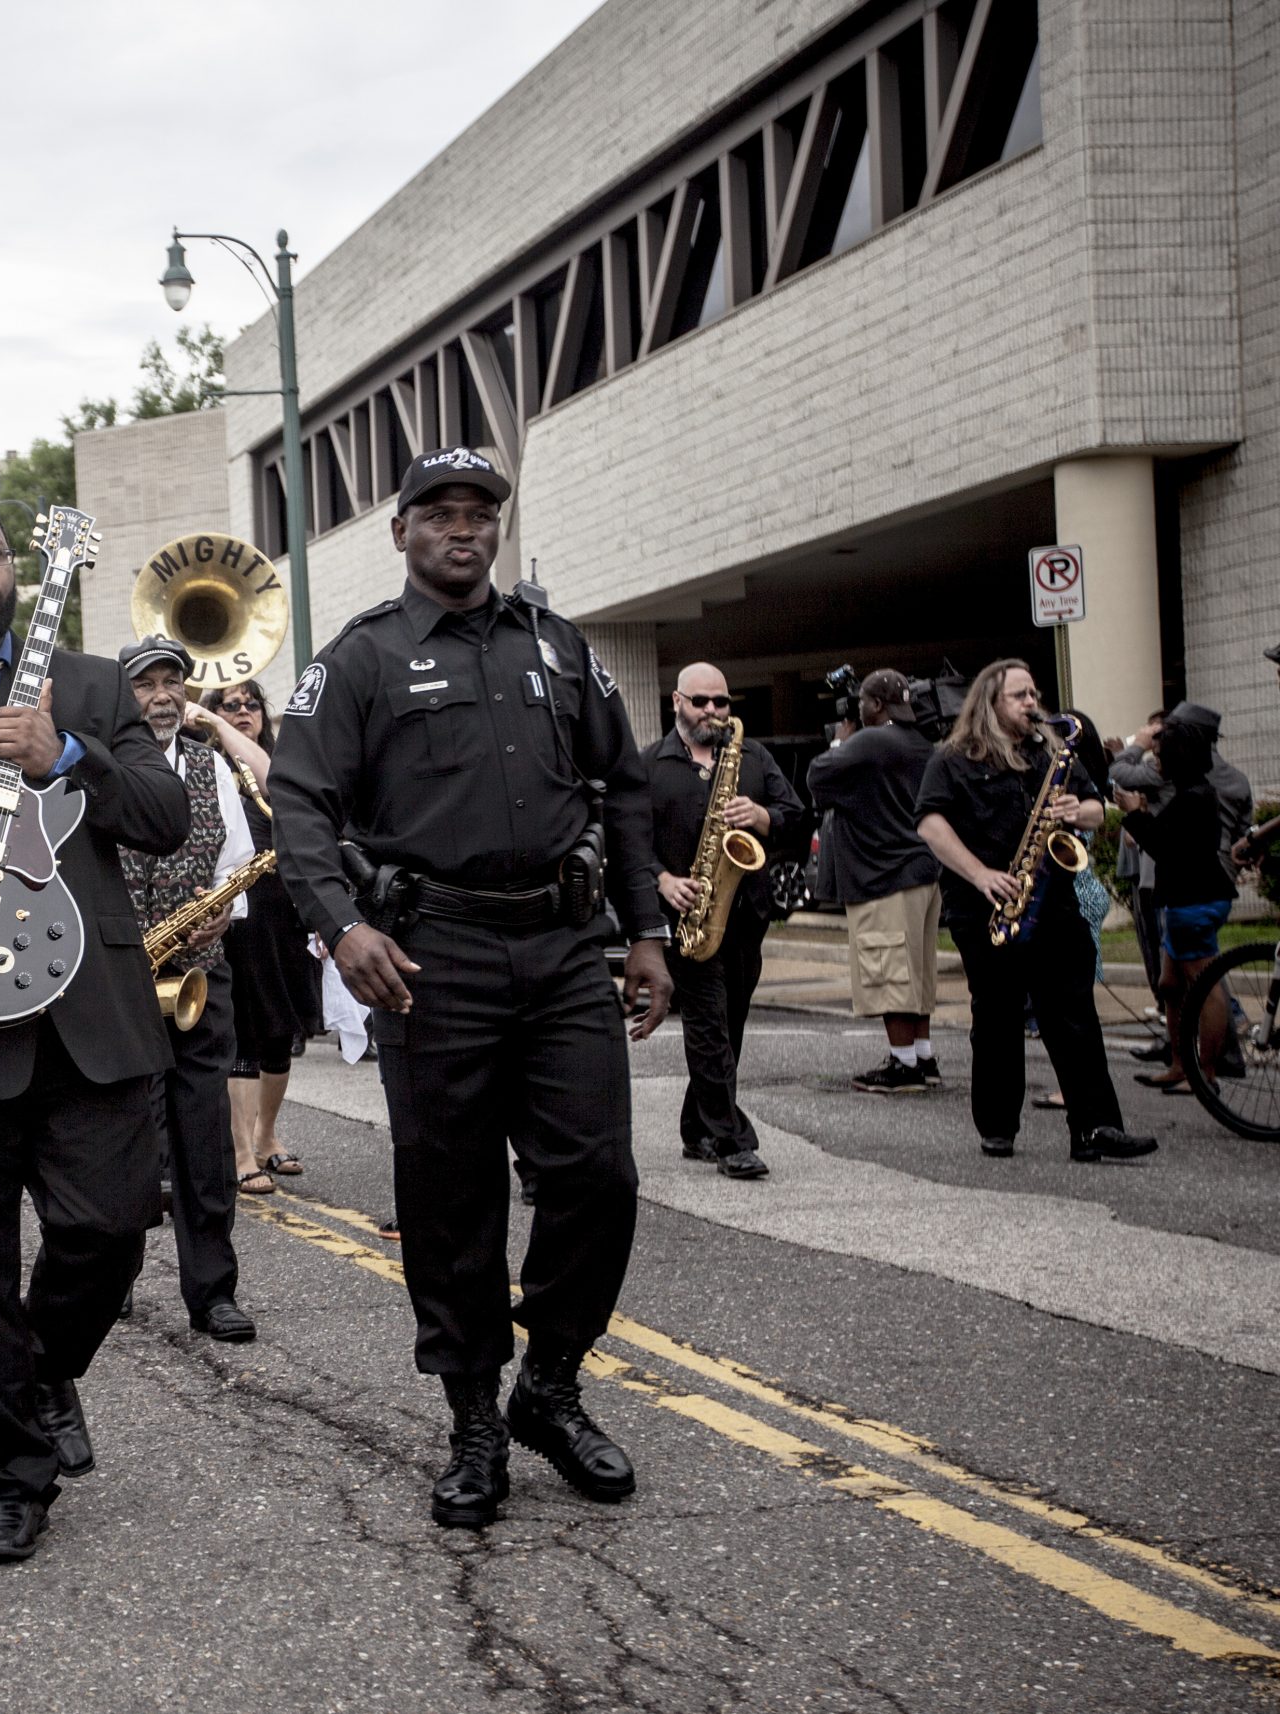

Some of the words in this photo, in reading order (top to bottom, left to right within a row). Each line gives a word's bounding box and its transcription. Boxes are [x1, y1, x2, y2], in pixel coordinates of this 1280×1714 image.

[150, 536, 281, 594] MIGHTY
[1049, 558, 1070, 585] P
[1039, 597, 1056, 610] Any
[1059, 595, 1079, 607] Time
[154, 632, 252, 683] ULS
